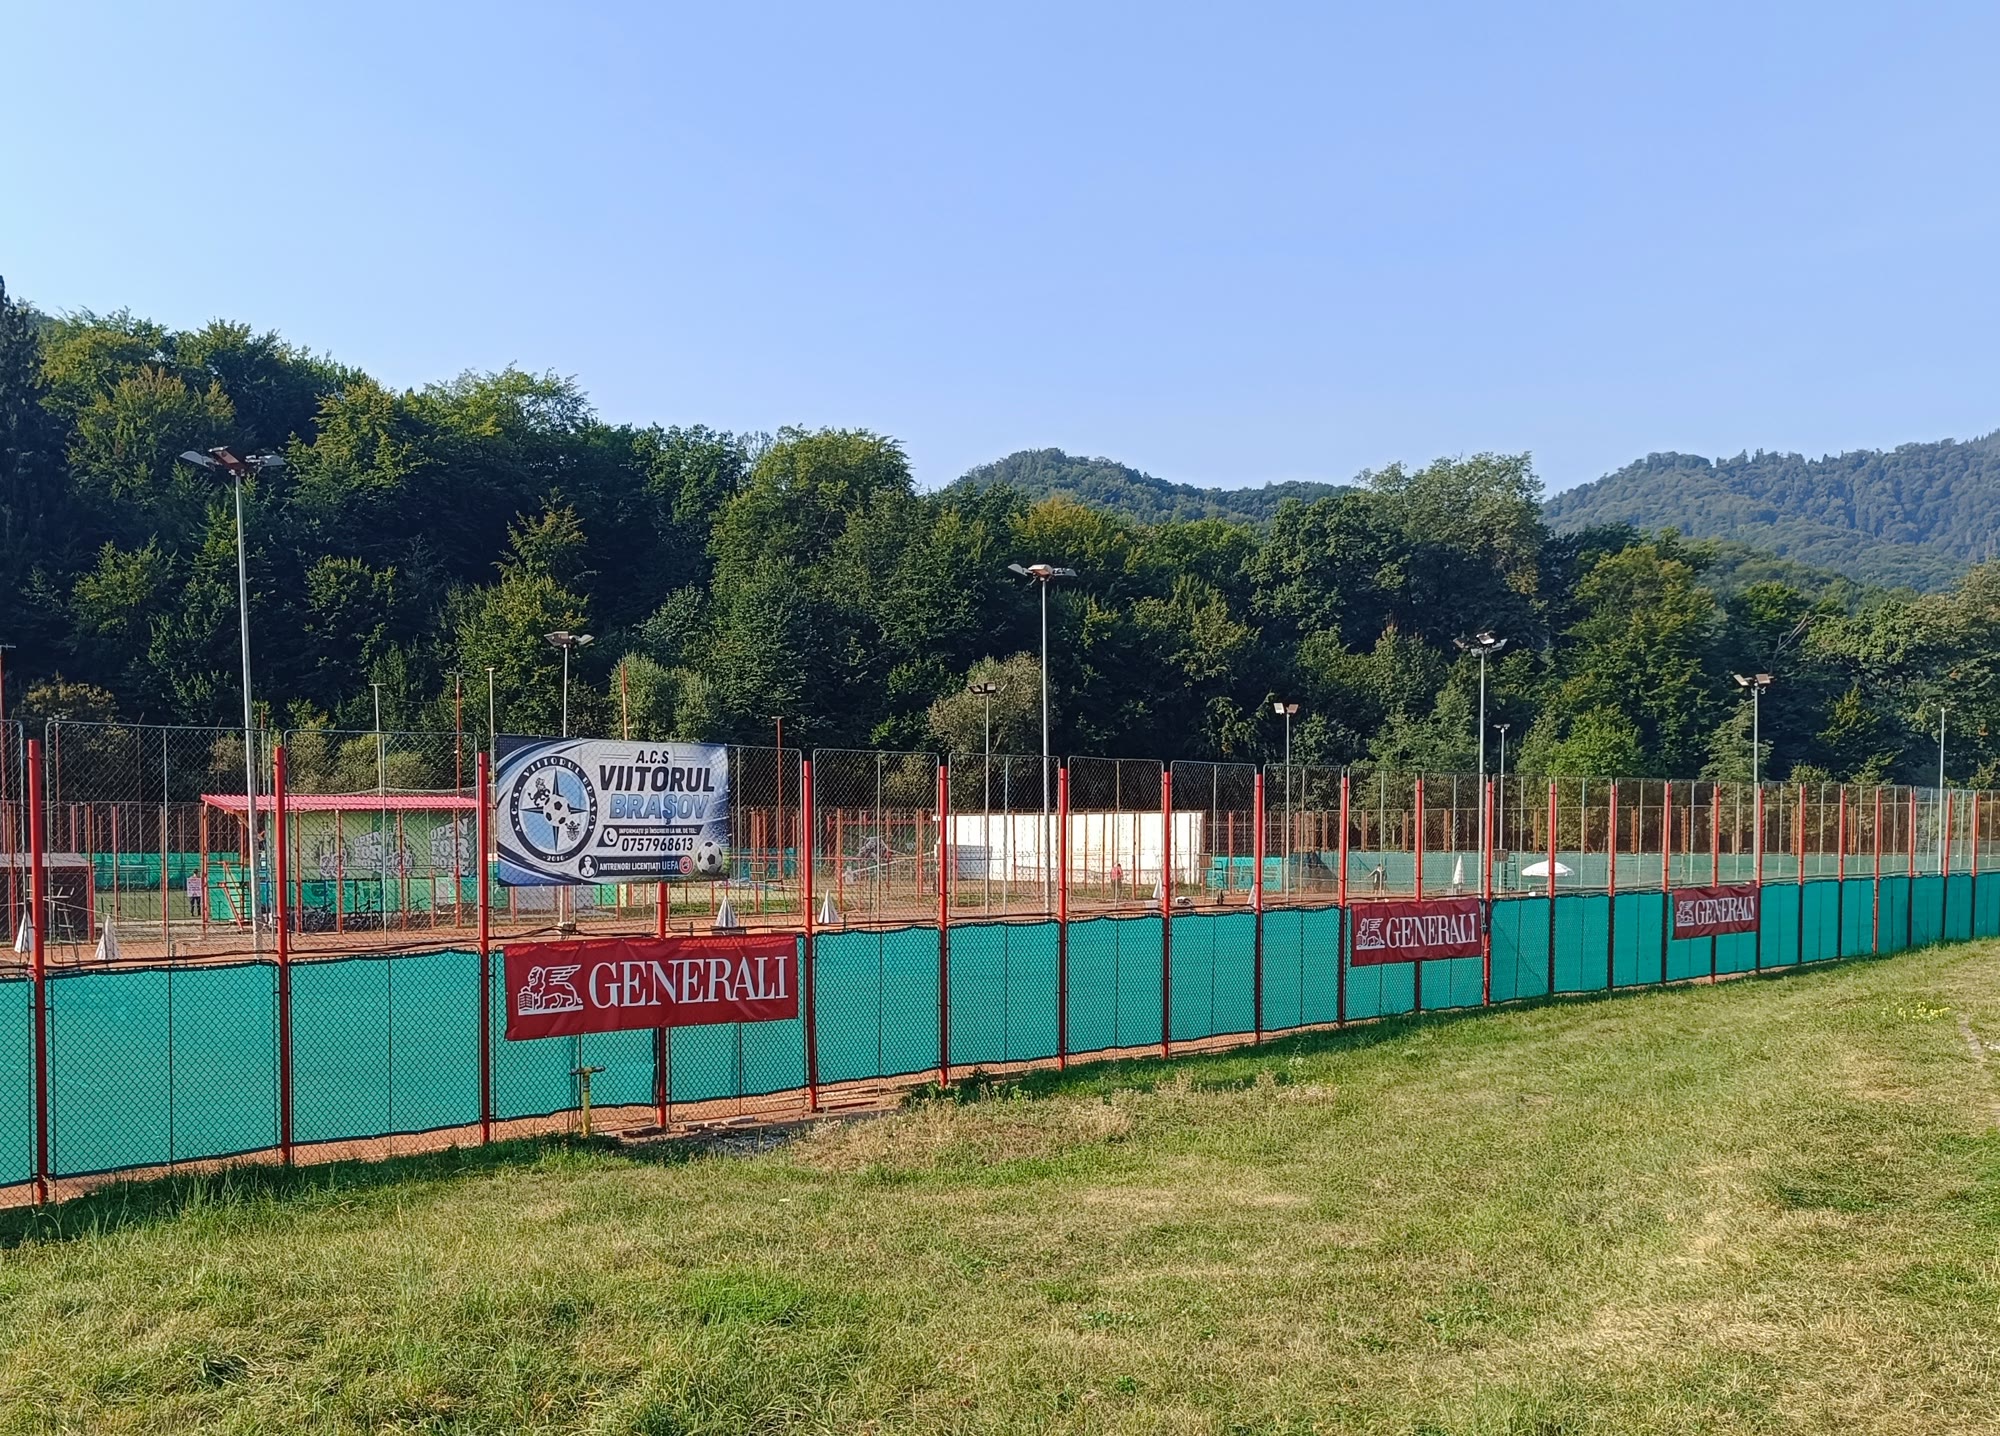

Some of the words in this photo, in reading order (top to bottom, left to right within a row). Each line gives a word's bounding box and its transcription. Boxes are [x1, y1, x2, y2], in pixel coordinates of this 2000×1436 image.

[635, 750, 669, 764] A.C.S
[599, 765, 714, 792] VIITORUL
[430, 818, 468, 840] OPEN
[431, 838, 469, 859] FOR
[621, 838, 693, 851] 0757968613
[599, 863, 630, 871] ANTRENORI
[661, 860, 678, 870] UEFA
[1695, 896, 1754, 925] GENERALI
[1386, 913, 1477, 948] GENERALI
[588, 956, 789, 1008] GENERALI
